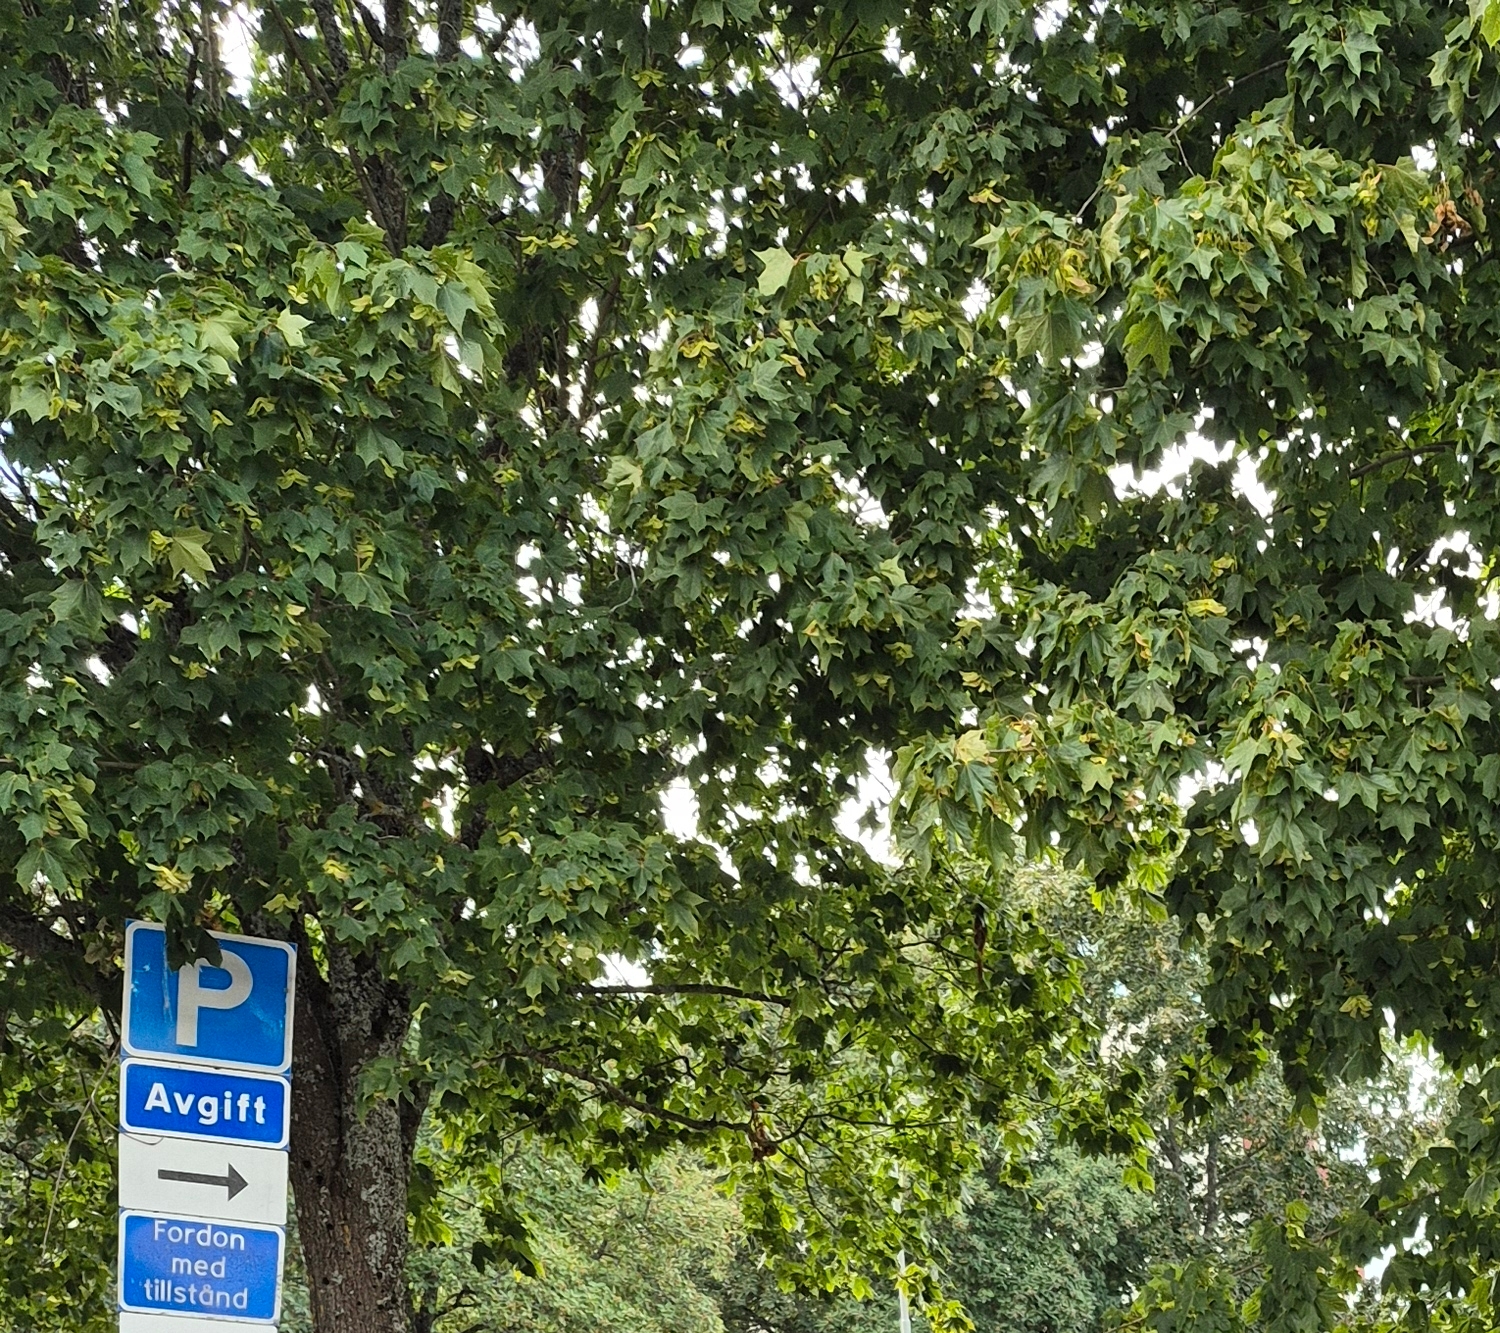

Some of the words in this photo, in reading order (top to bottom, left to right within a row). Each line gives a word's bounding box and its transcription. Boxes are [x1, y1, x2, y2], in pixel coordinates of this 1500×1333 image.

[176, 949, 254, 1047] P
[144, 1082, 266, 1125] Avgift
[154, 1219, 246, 1251] Fordon
[171, 1256, 226, 1279] med
[143, 1278, 248, 1310] tillstånd
